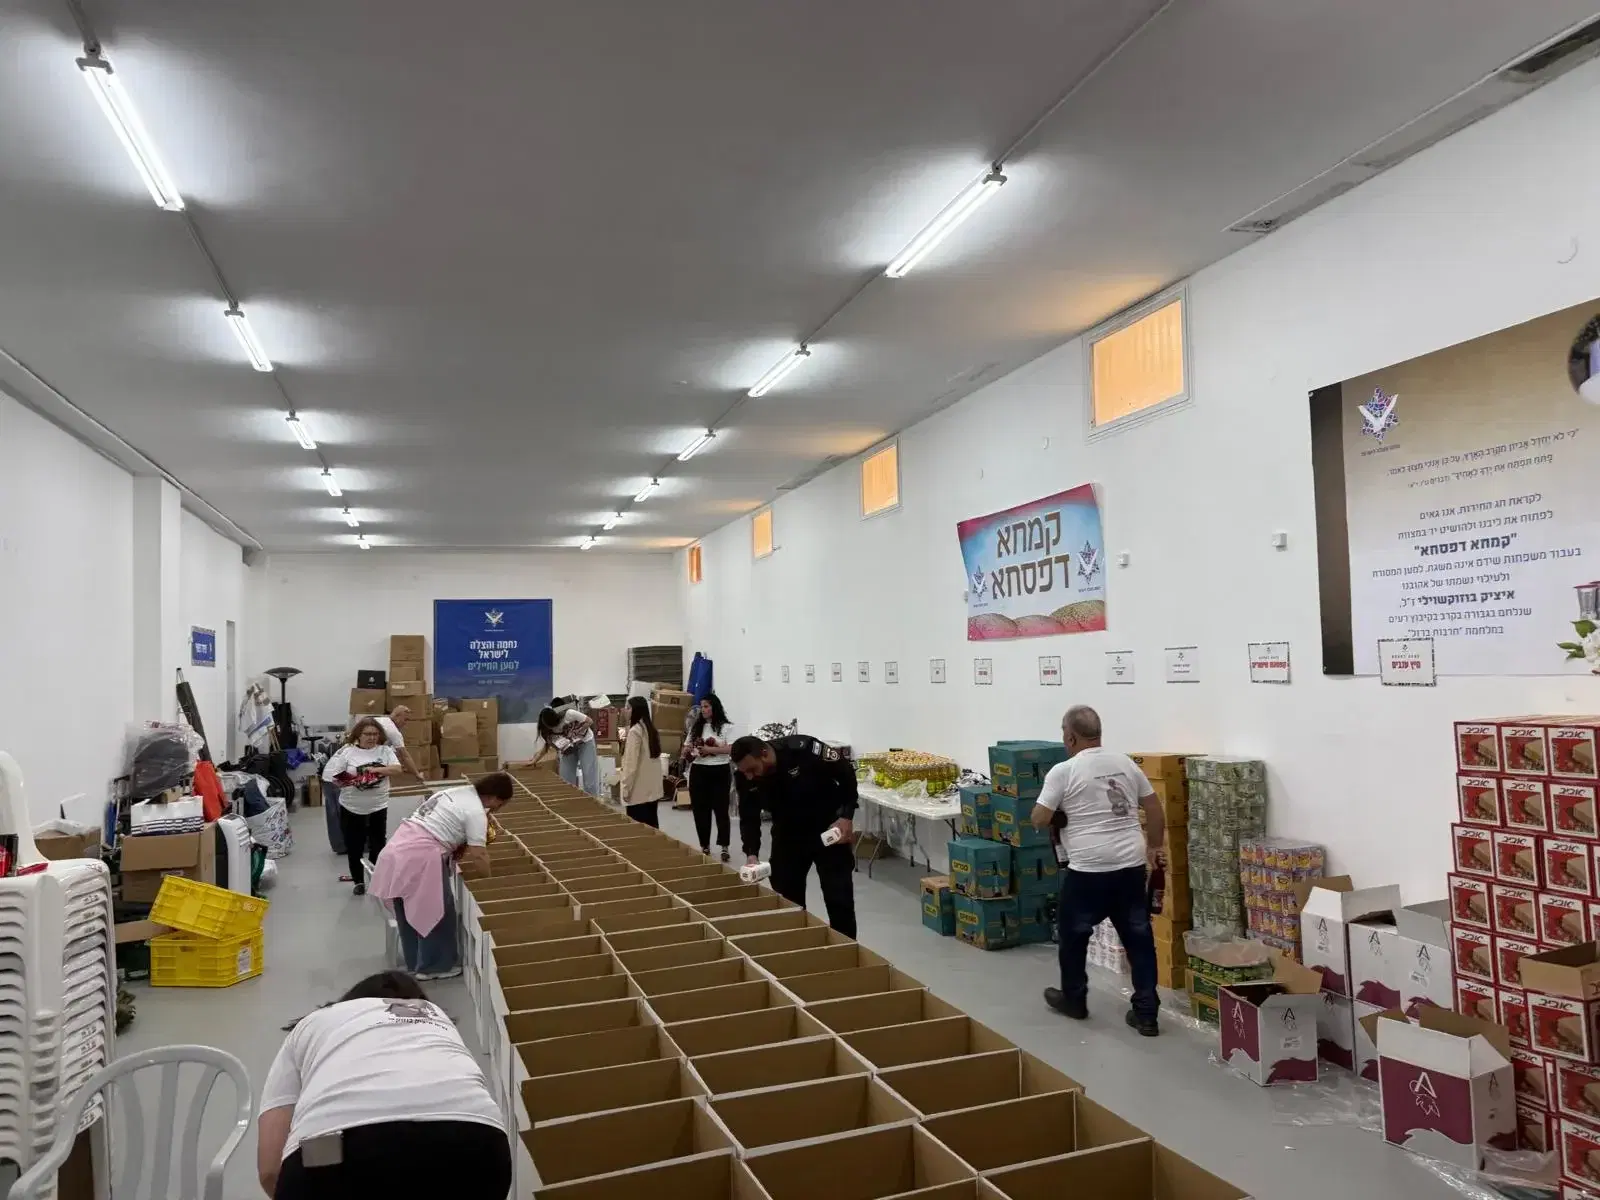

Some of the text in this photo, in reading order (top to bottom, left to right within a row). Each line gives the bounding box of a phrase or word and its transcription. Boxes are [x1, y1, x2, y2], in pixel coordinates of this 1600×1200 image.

[1494, 499, 1506, 509] חג
[1508, 493, 1542, 507] לקראת
[1419, 510, 1440, 520] גאים
[1442, 507, 1455, 517] אנו
[1520, 510, 1553, 523] לפתוח
[1479, 517, 1502, 529] ליבנו
[1503, 515, 1518, 525] את
[1428, 527, 1438, 535] יד
[1440, 521, 1477, 534] ולהושיט
[997, 511, 1061, 558] קמחא
[1414, 532, 1517, 557] "קמחא דפסחא"
[1503, 551, 1547, 565] משפחות
[1549, 547, 1582, 560] בעבור
[1454, 560, 1474, 569] אינה
[1476, 557, 1501, 567] שידם
[1403, 564, 1424, 576] למען
[991, 554, 1070, 600] דפסחא
[1401, 571, 1510, 590] ולעילוי נשמתו של אהובנו
[1480, 590, 1515, 603] איציק
[1388, 607, 1532, 623] שנלחם בגבורה בקרב בקיבוץ רעים
[1433, 627, 1462, 636] "חרבות
[1465, 625, 1504, 636] במלחמת
[470, 639, 518, 650] נחמה והצלה
[478, 649, 509, 659] לישראל
[467, 660, 520, 672] למען החיילים
[1511, 729, 1536, 737] אביב
[1557, 730, 1585, 738] אביב
[1466, 779, 1489, 787] אביב
[1511, 782, 1536, 791] אביב
[1559, 787, 1586, 796] אביב
[1503, 836, 1527, 845] אביב
[1552, 843, 1579, 852] אביב
[1502, 888, 1527, 897] אביב
[1547, 897, 1574, 908] אביב
